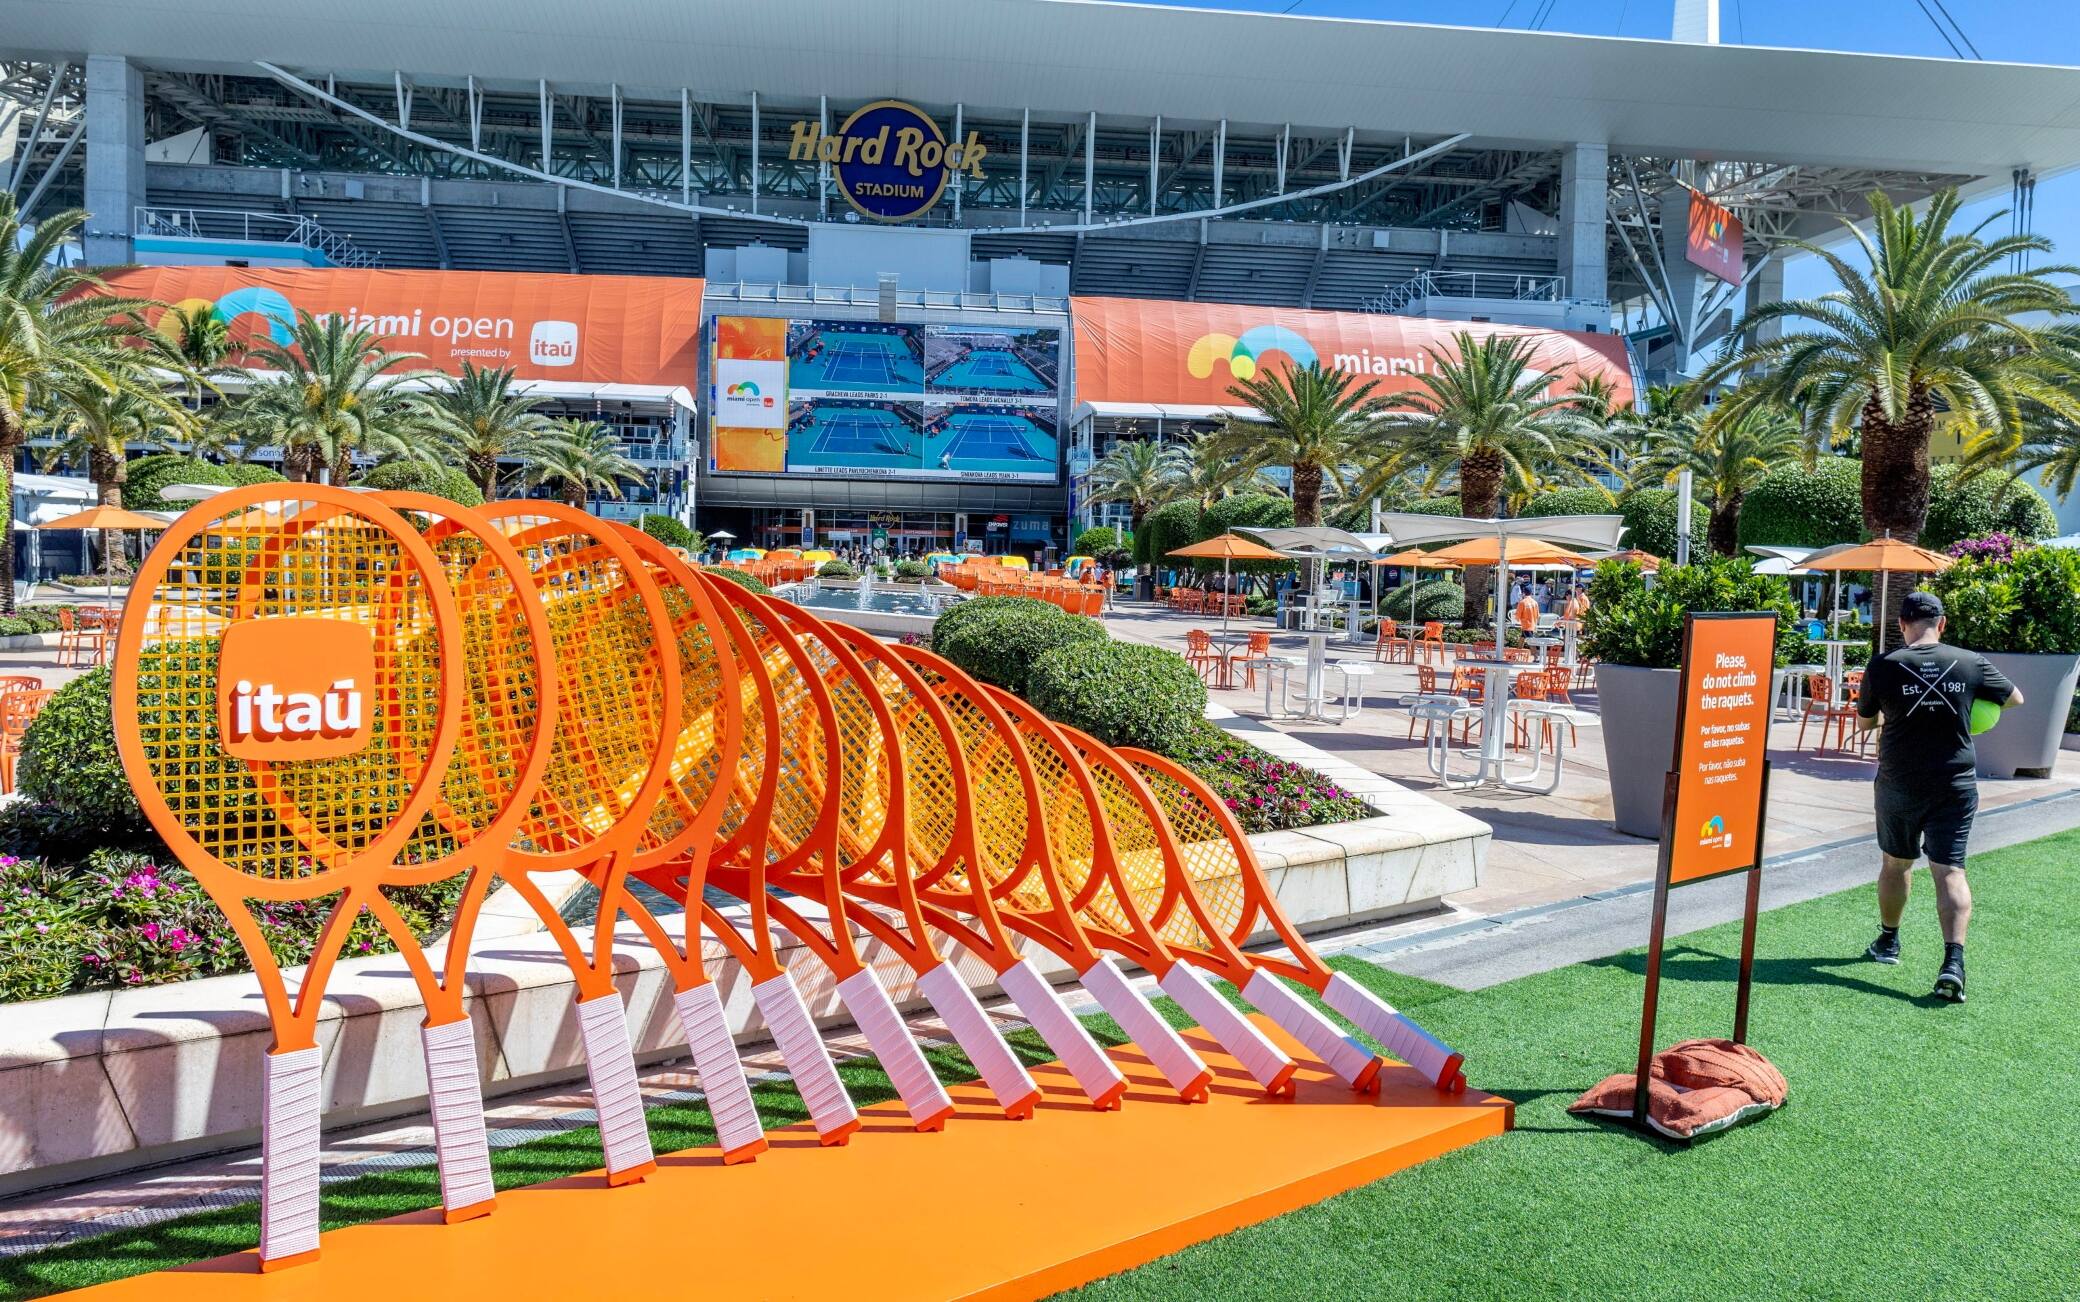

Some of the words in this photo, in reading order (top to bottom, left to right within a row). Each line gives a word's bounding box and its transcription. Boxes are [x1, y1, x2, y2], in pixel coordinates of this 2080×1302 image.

[789, 121, 890, 165] Hard
[894, 126, 988, 179] Rock
[855, 182, 924, 198] STADIUM
[430, 315, 514, 344] open
[451, 347, 497, 358] presented
[499, 348, 512, 359] by
[1334, 349, 1424, 376] miami
[1013, 520, 1049, 531] zuma
[1716, 652, 1747, 669] Please,
[1703, 673, 1714, 690] do
[1716, 673, 1732, 689] not
[1733, 671, 1757, 687] climb
[1902, 684, 1923, 695] Est.
[1942, 681, 1966, 693] 1981
[1701, 694, 1717, 710] the
[1718, 692, 1754, 711] raquets.
[1701, 726, 1710, 735] Por
[1711, 725, 1727, 734] favor,
[1699, 763, 1708, 772] Por
